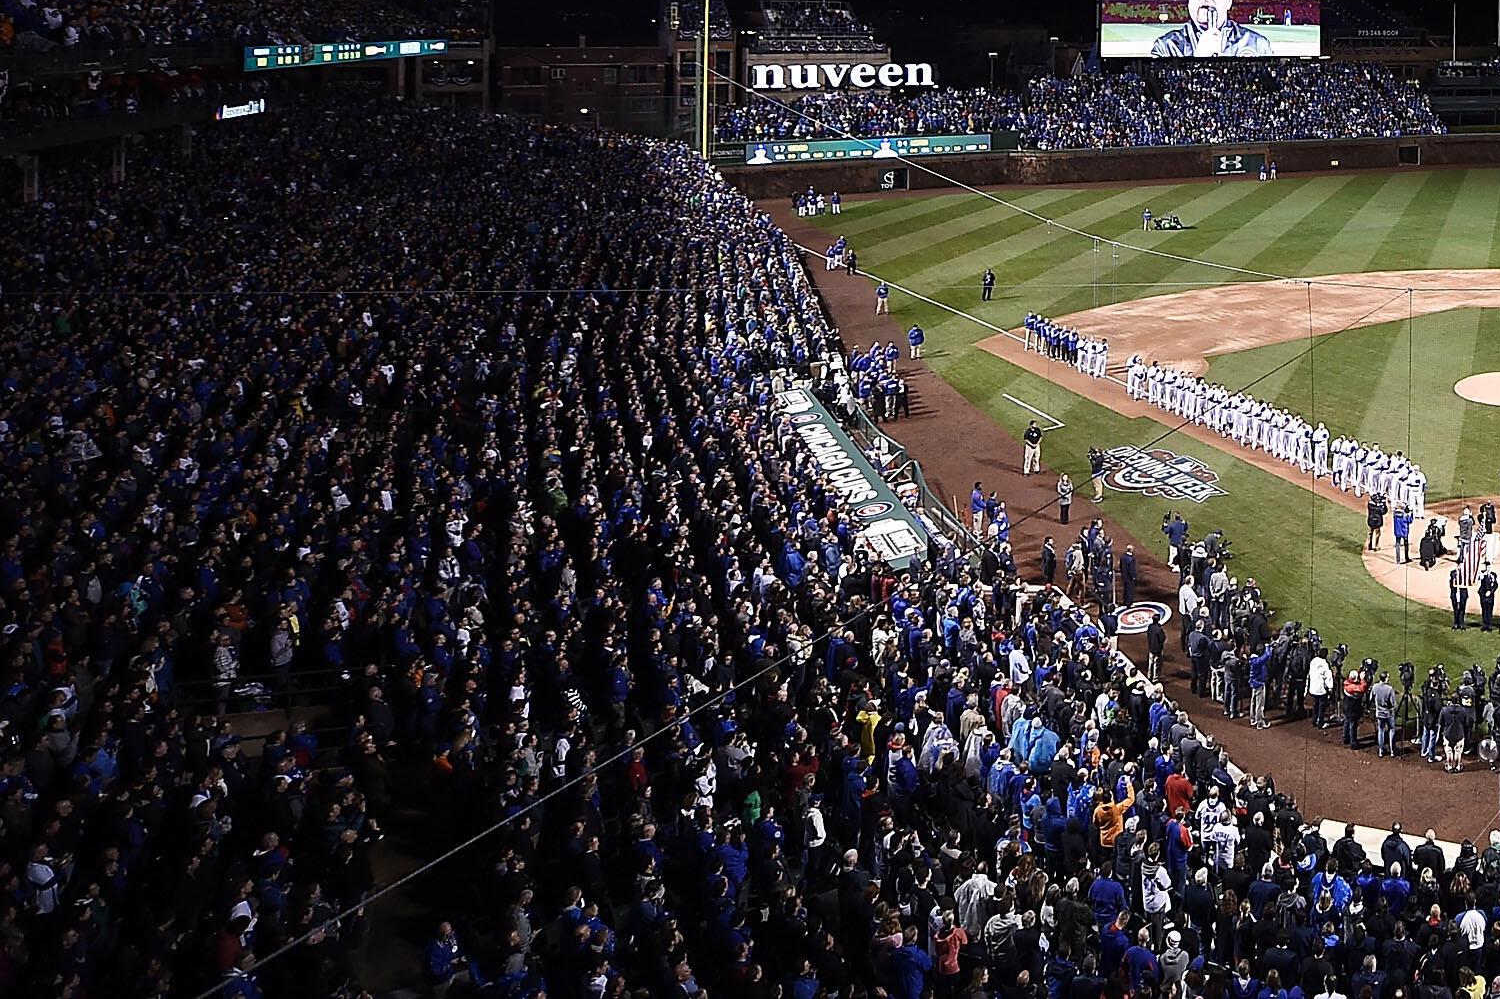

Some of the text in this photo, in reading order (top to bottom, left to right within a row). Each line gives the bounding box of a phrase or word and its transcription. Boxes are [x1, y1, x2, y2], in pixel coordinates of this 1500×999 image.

[752, 62, 935, 89] nuveen
[796, 423, 878, 504] CHICAGO CUBS
[1104, 445, 1223, 500] OPENING WEEK
